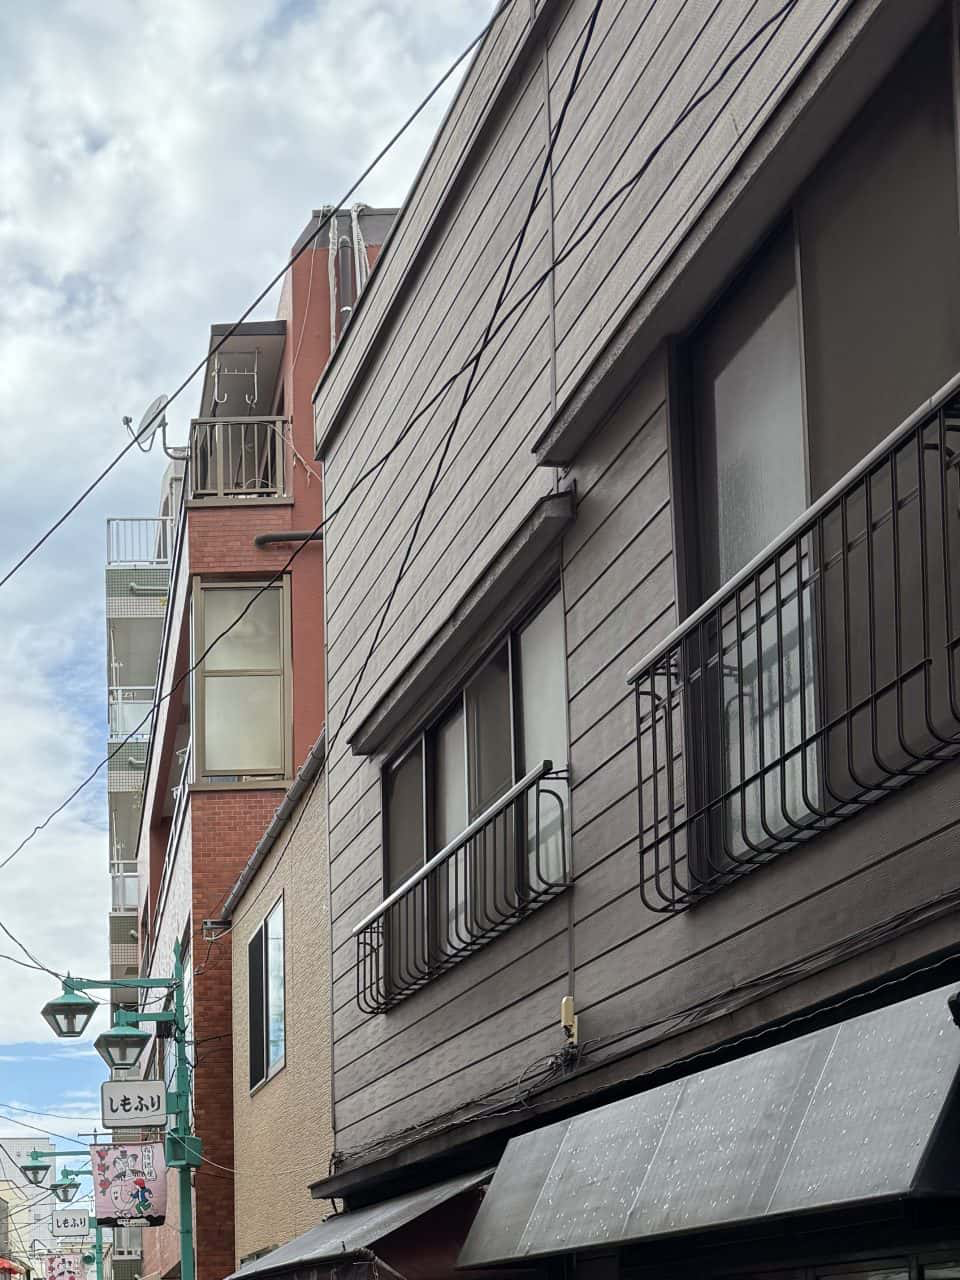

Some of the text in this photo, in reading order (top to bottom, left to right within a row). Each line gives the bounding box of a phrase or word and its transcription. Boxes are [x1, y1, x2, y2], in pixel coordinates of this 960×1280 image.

[109, 1094, 161, 1112] しもふり
[56, 1217, 86, 1228] しもふり
